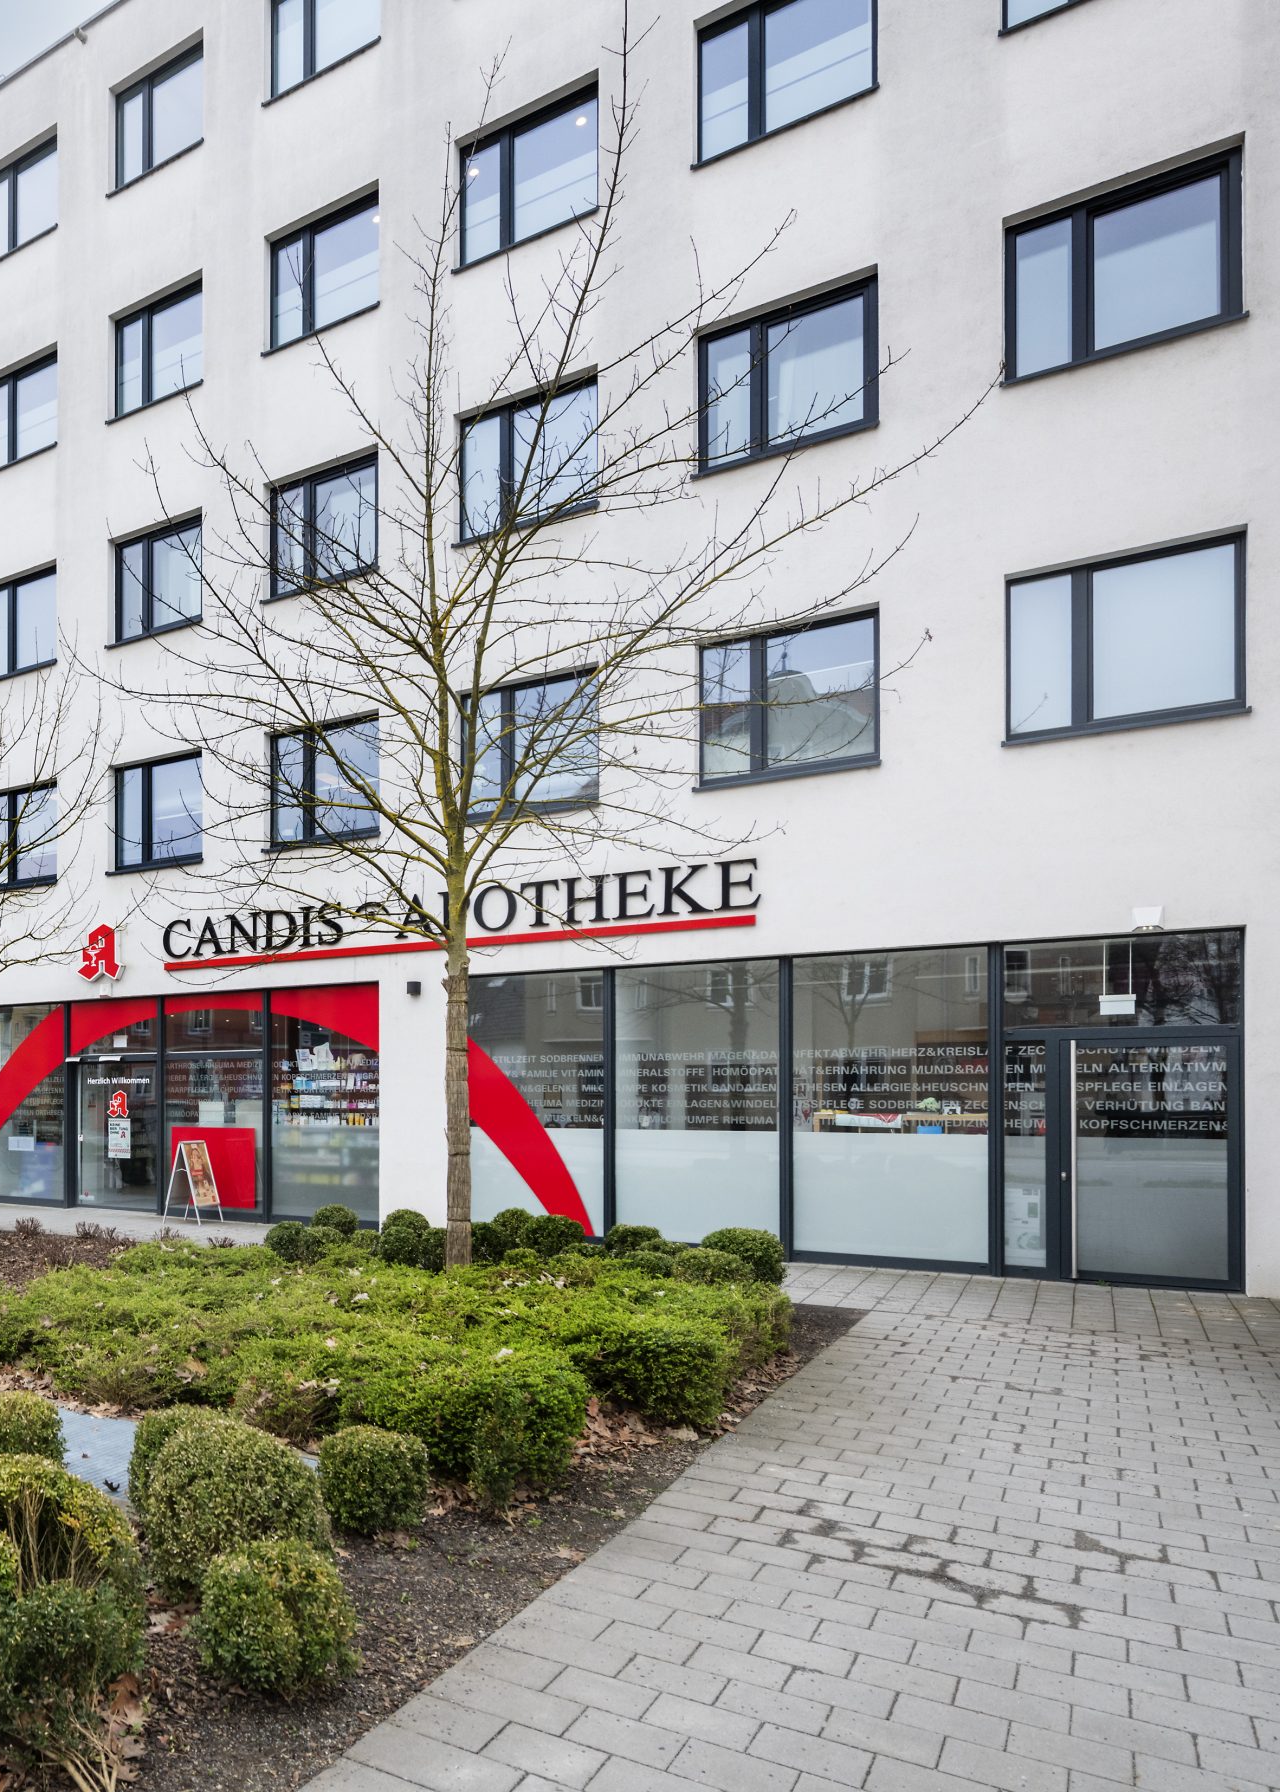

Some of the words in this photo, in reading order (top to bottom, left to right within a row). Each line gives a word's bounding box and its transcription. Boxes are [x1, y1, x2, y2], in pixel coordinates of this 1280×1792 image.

[163, 902, 343, 958] CANDIS
[87, 1077, 111, 1085] Herzlich
[1084, 1099, 1185, 1111] VERHÜTUNG
